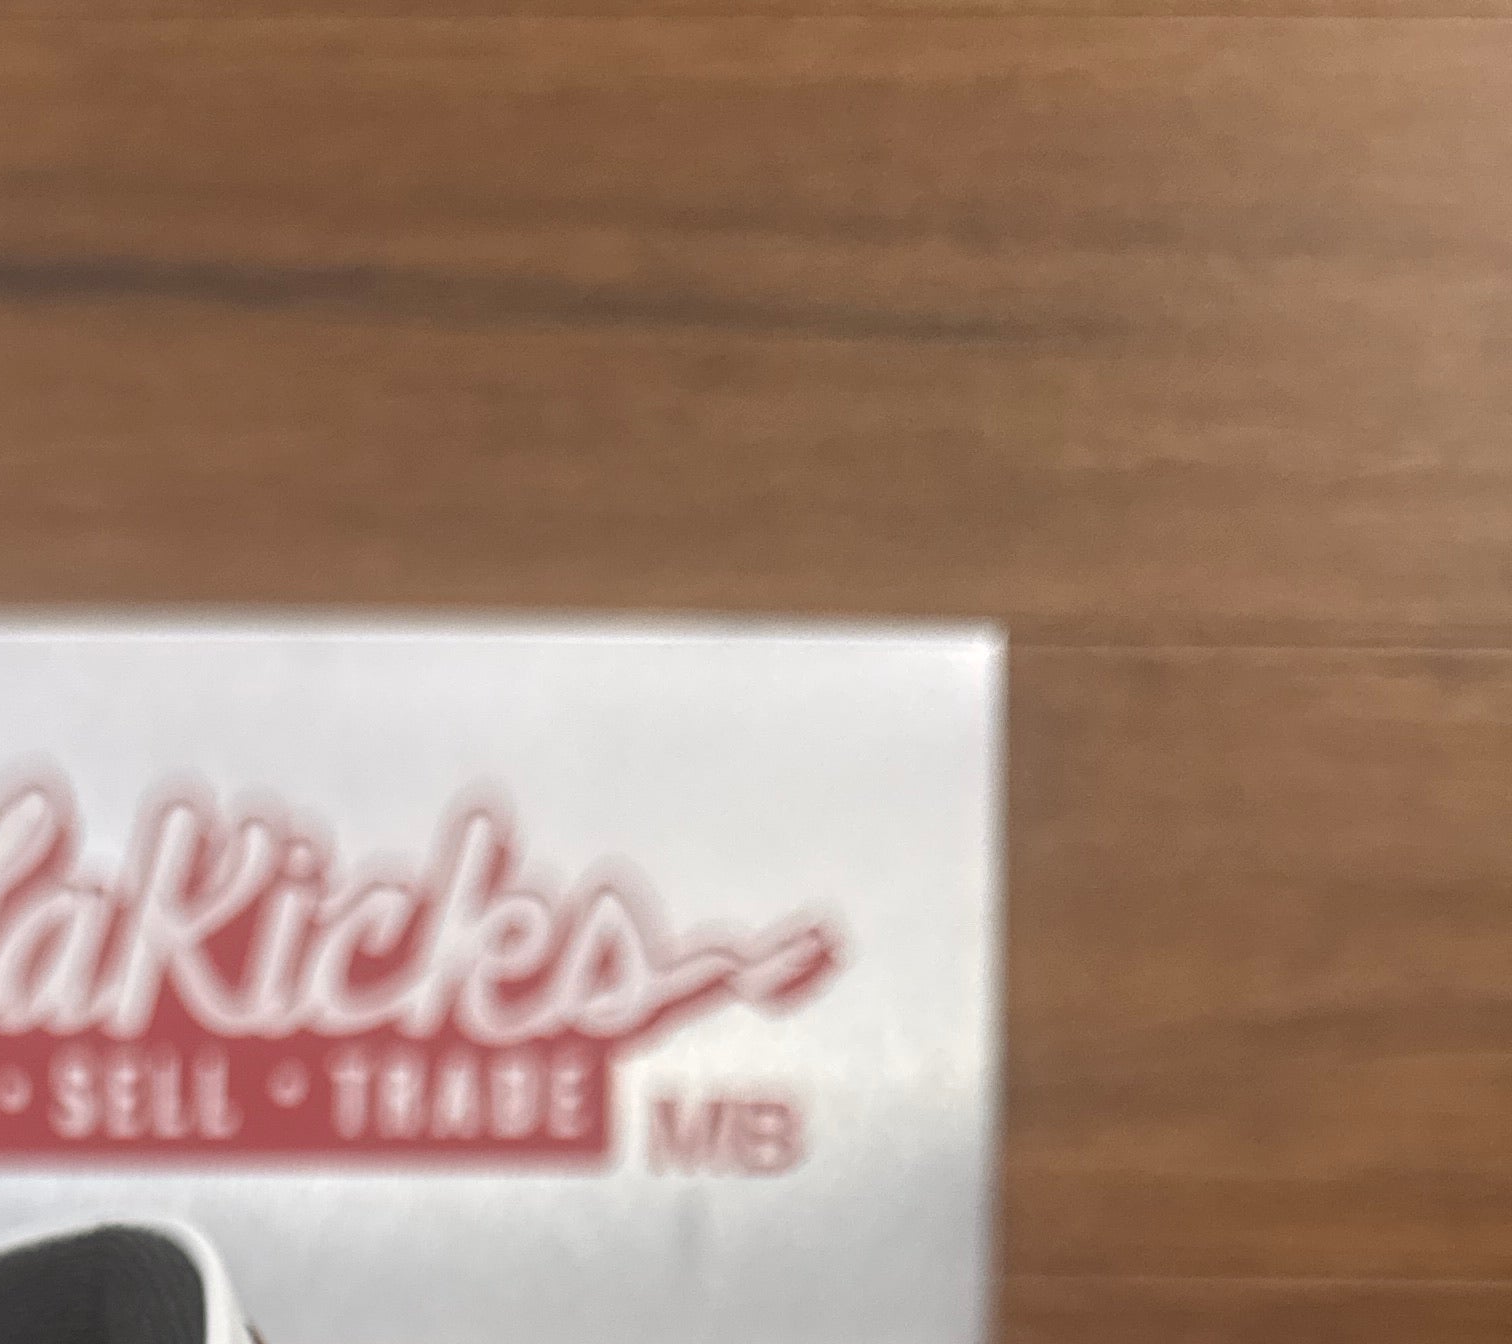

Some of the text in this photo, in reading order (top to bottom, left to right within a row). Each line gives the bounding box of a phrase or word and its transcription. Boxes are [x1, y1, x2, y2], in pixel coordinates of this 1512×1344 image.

[50, 1042, 240, 1140] SELL
[330, 1045, 593, 1140] TRADE
[648, 1098, 804, 1174] MB
